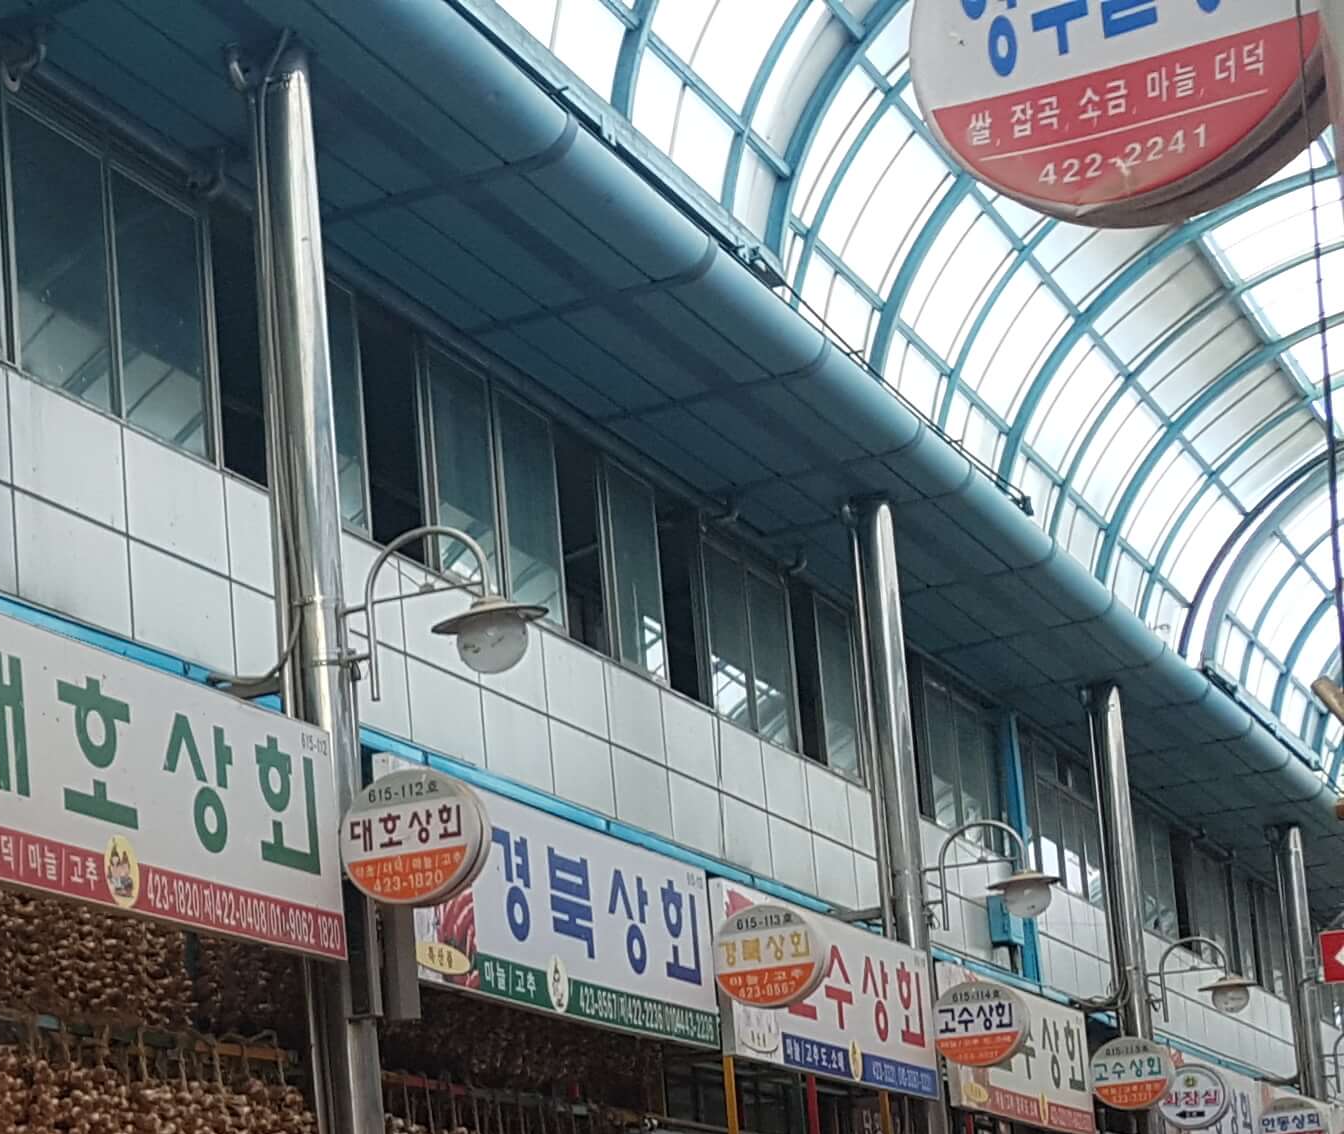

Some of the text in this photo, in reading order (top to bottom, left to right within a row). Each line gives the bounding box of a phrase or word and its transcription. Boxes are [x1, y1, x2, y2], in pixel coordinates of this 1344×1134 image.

[1011, 97, 1070, 141] 잡곡,
[1078, 80, 1137, 125] 소금,
[1147, 62, 1204, 101] 마늘,
[1213, 39, 1266, 84] 더덕
[1038, 124, 1209, 187] 422-2241
[368, 780, 439, 804] 615-112호
[350, 804, 462, 853] 대호상회
[374, 869, 443, 892] 423-1820
[491, 827, 703, 987] 경북상회
[719, 930, 810, 967] 경북상회
[789, 944, 926, 1048] 수상회
[938, 1001, 1013, 1034] 고수상회
[1093, 1056, 1162, 1081] 고수상회
[1163, 1089, 1218, 1106] 화장실
